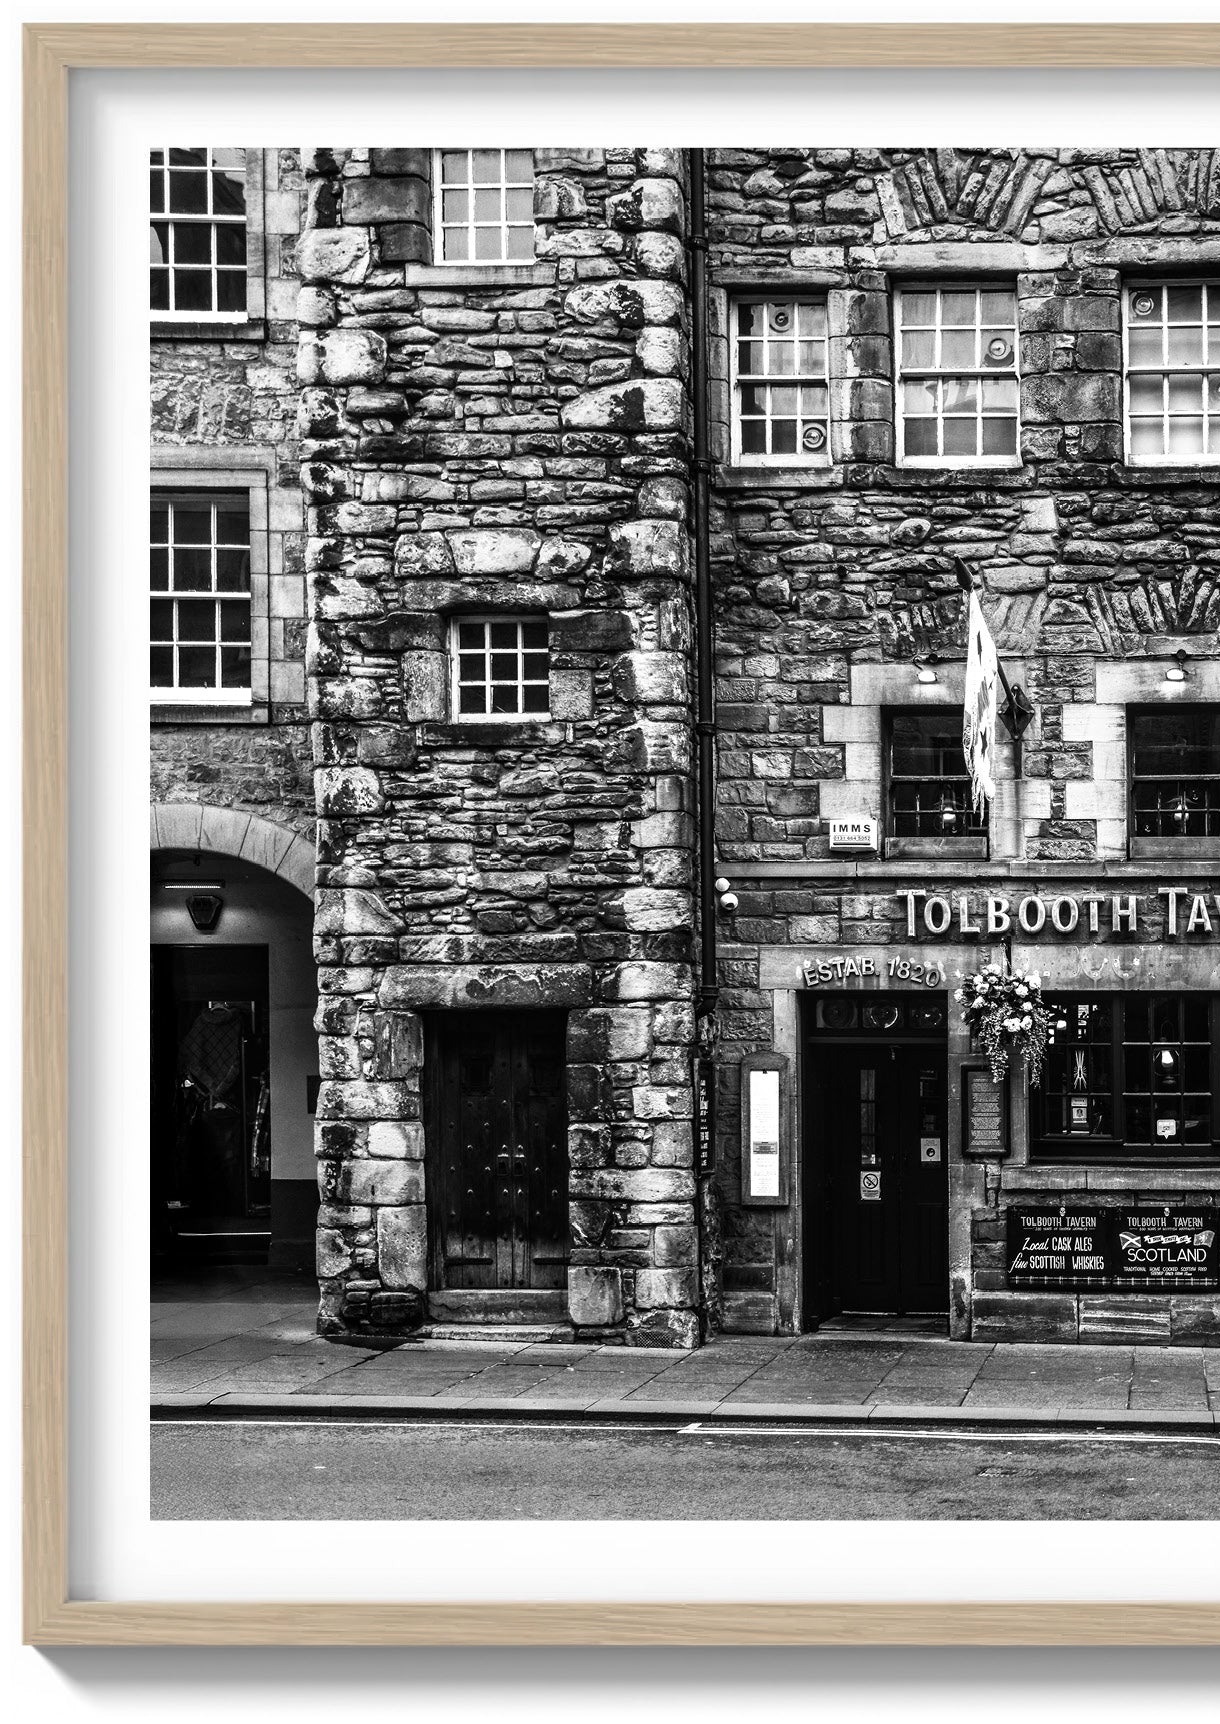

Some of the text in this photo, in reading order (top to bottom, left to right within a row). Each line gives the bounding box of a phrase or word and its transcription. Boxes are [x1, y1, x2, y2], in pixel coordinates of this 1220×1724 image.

[833, 824, 871, 832] IMMS
[896, 889, 1138, 937] TOLBOOTH
[803, 955, 941, 988] ESTAB. 1820
[1020, 1216, 1097, 1227] TOLBOOTH TAVERN
[1127, 1216, 1203, 1227] TOLBOOTH TAVERN
[1022, 1236, 1093, 1251] Local CASK ALES
[1127, 1248, 1207, 1262] SCOTLAND
[1007, 1252, 1105, 1273] fine SCOTTISH WHISKIES
